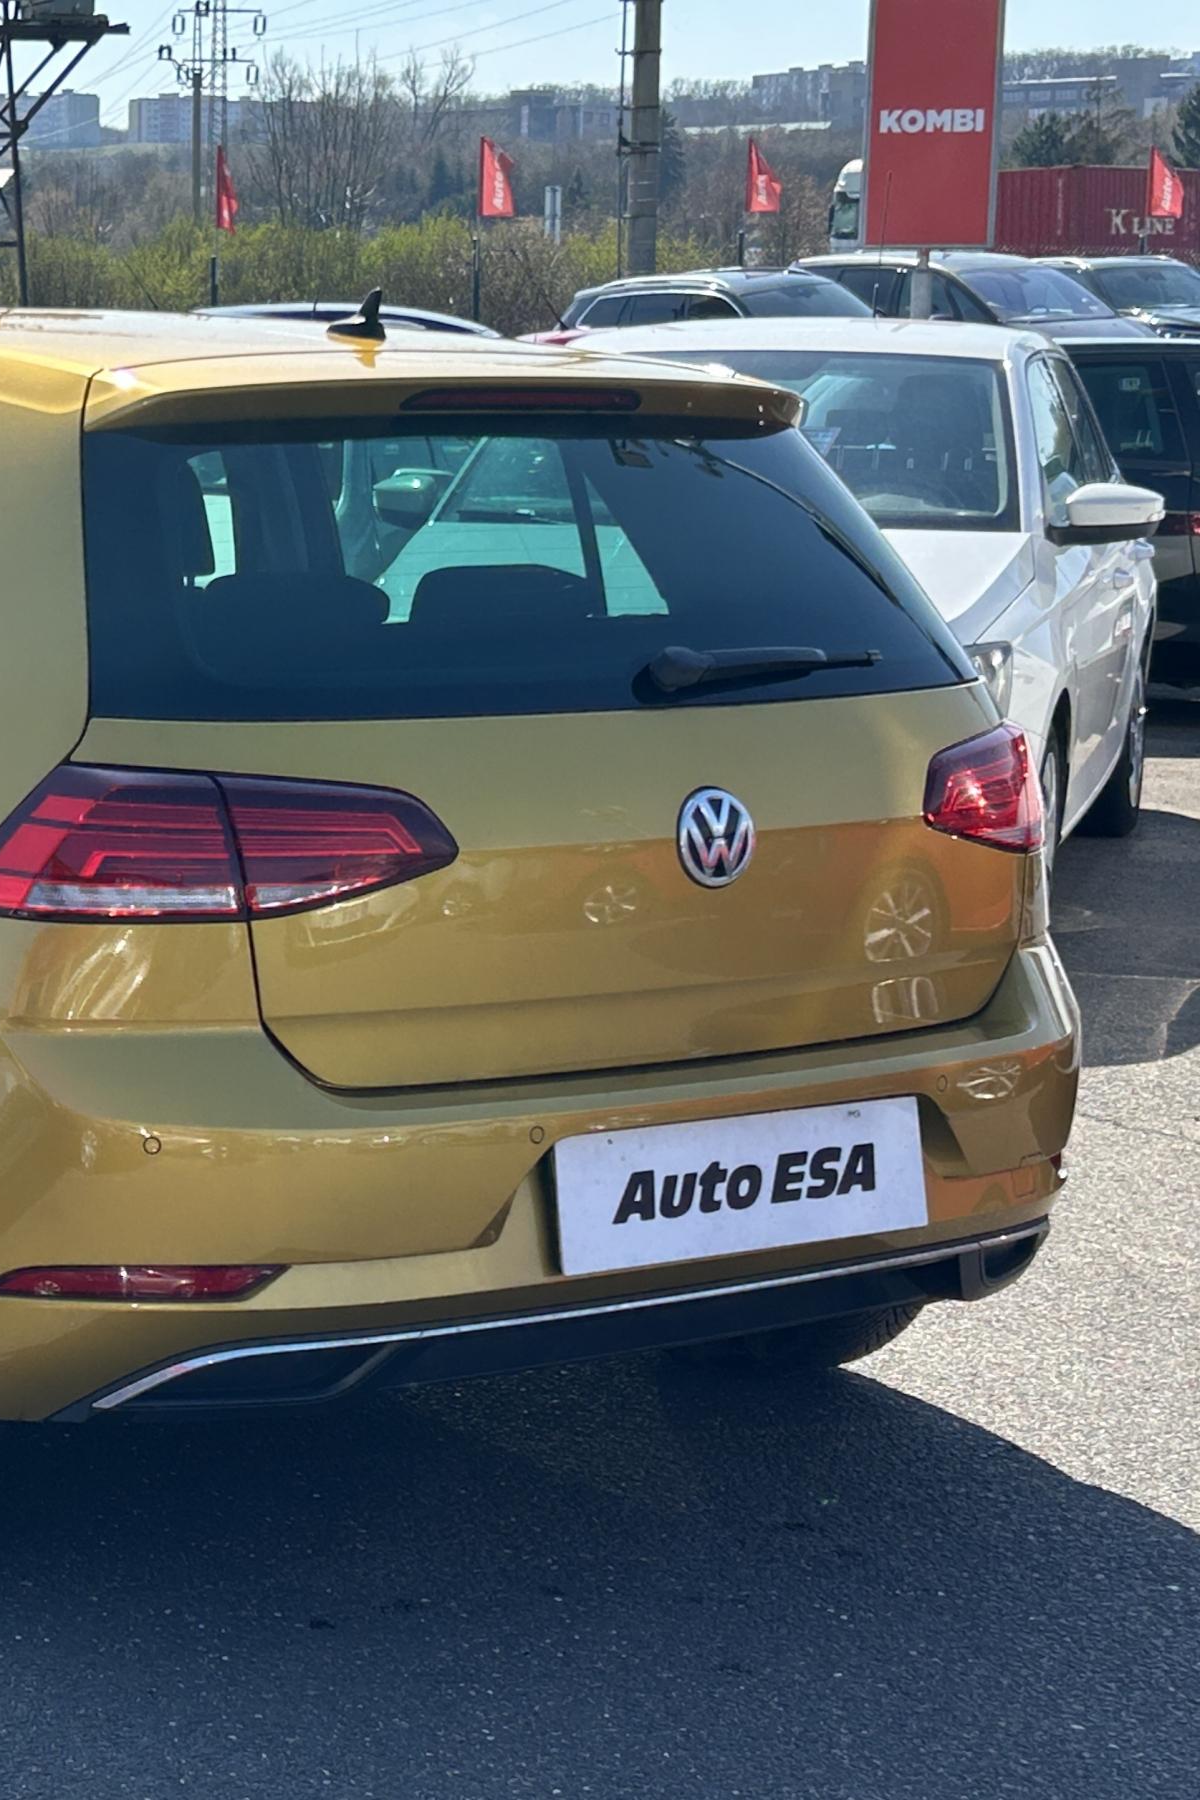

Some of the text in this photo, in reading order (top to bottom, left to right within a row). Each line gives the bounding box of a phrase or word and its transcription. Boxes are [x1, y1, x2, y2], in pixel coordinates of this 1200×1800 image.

[880, 108, 984, 133] KOMBI
[612, 1143, 876, 1224] Auto ESA
